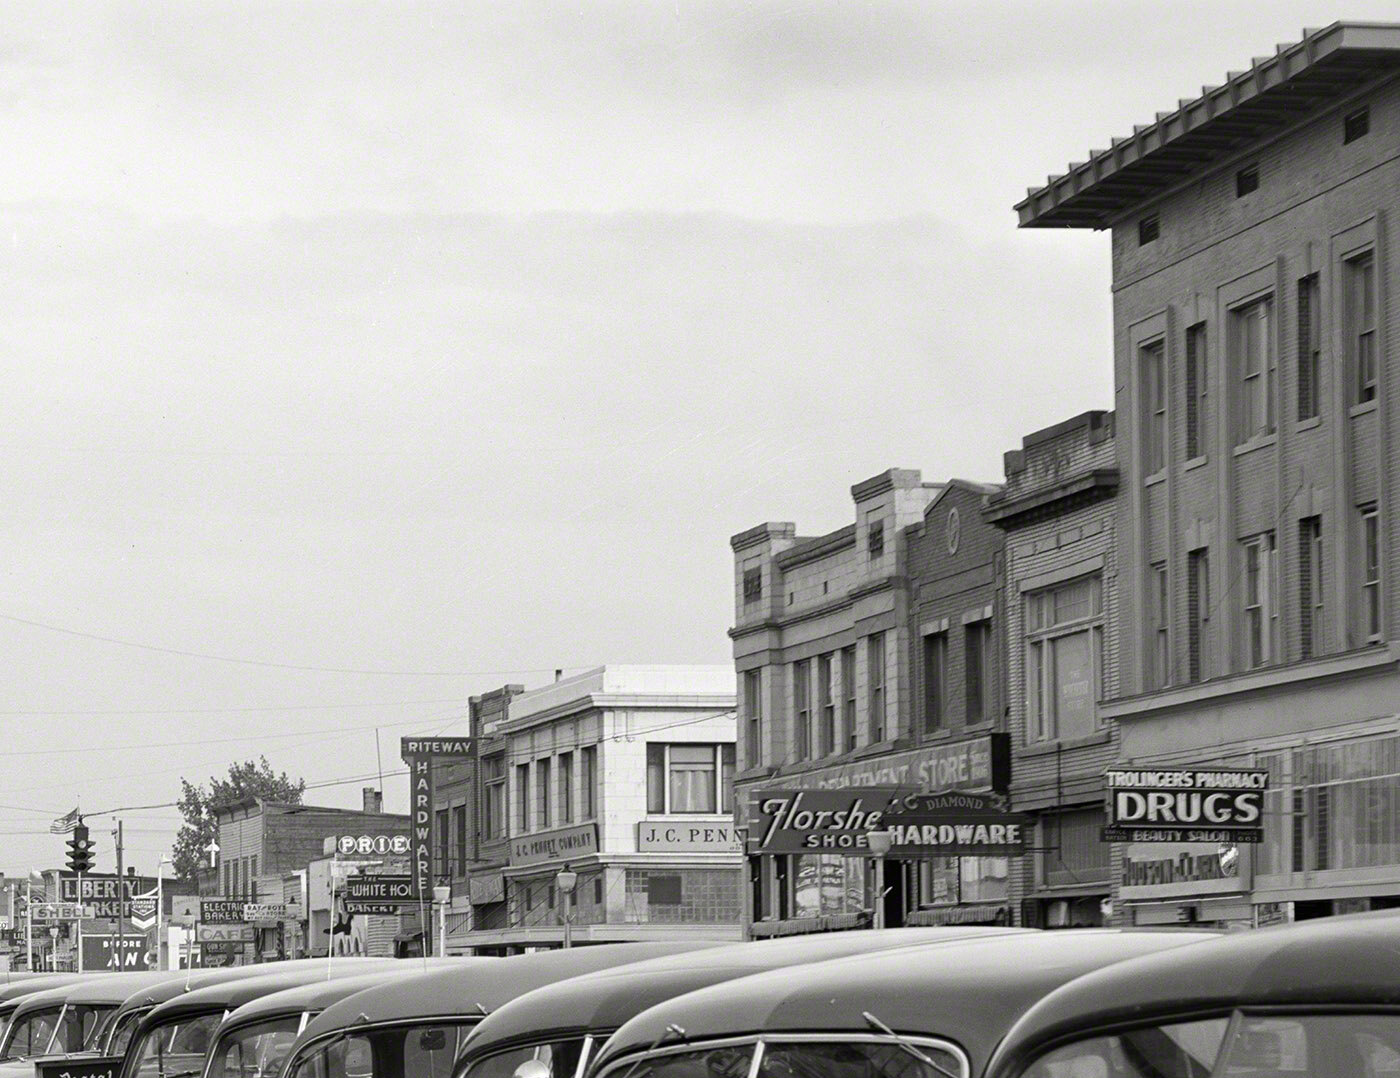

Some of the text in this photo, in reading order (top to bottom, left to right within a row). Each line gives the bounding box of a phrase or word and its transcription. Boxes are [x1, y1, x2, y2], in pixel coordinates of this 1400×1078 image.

[408, 741, 472, 753] RITEWAY
[918, 754, 969, 786] STORE
[1106, 770, 1269, 789] TROLINGER'S PHARMACY
[925, 796, 984, 812] DIAMOND
[1116, 791, 1260, 823] DRUGS
[416, 761, 430, 890] HARDWARE
[761, 791, 883, 849] Florshe
[558, 832, 591, 850] COMPANY
[646, 828, 742, 843] J. C. PENN
[806, 833, 869, 849] SHOE
[888, 823, 1022, 846] HARDWARE
[1132, 829, 1183, 842] BEAUTY
[1187, 830, 1231, 842] SALON
[64, 880, 139, 899] LIBERTY
[352, 884, 386, 897] WHITE
[38, 907, 91, 918] SHELL
[81, 901, 132, 917] ARKET
[204, 902, 245, 912] ELECTRIC
[204, 911, 245, 921] BAKERY
[200, 928, 253, 940] CAFE
